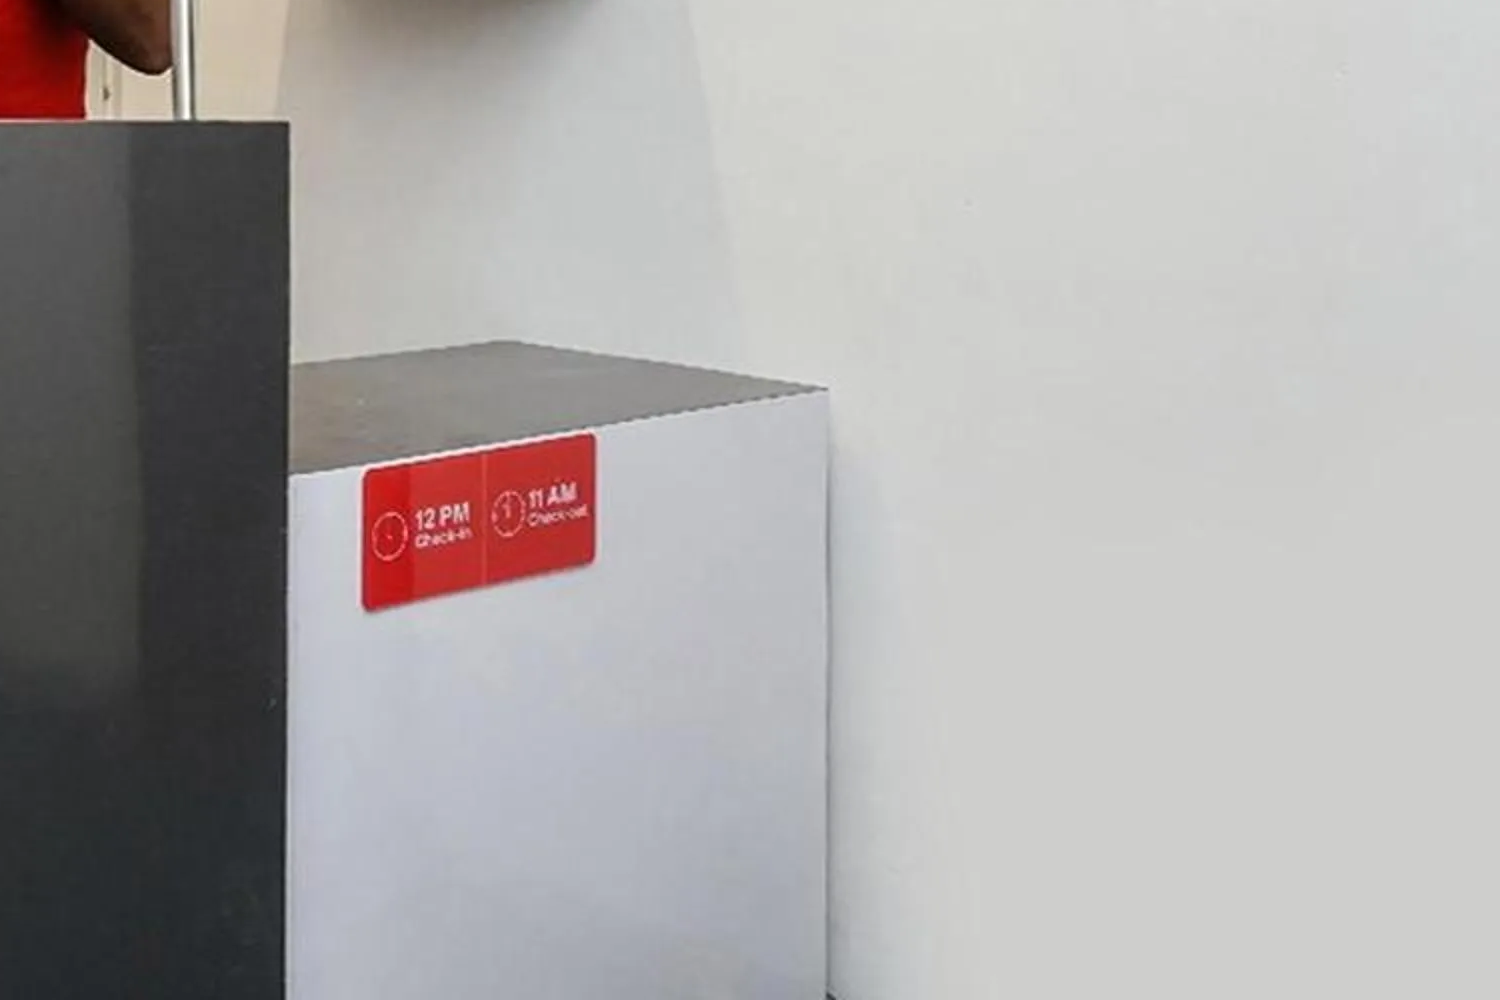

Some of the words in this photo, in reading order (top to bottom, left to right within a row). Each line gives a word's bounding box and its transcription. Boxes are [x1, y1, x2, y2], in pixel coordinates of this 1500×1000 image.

[528, 488, 543, 508] 11
[546, 481, 577, 506] AM
[414, 506, 436, 531] 12
[439, 501, 470, 527] PM
